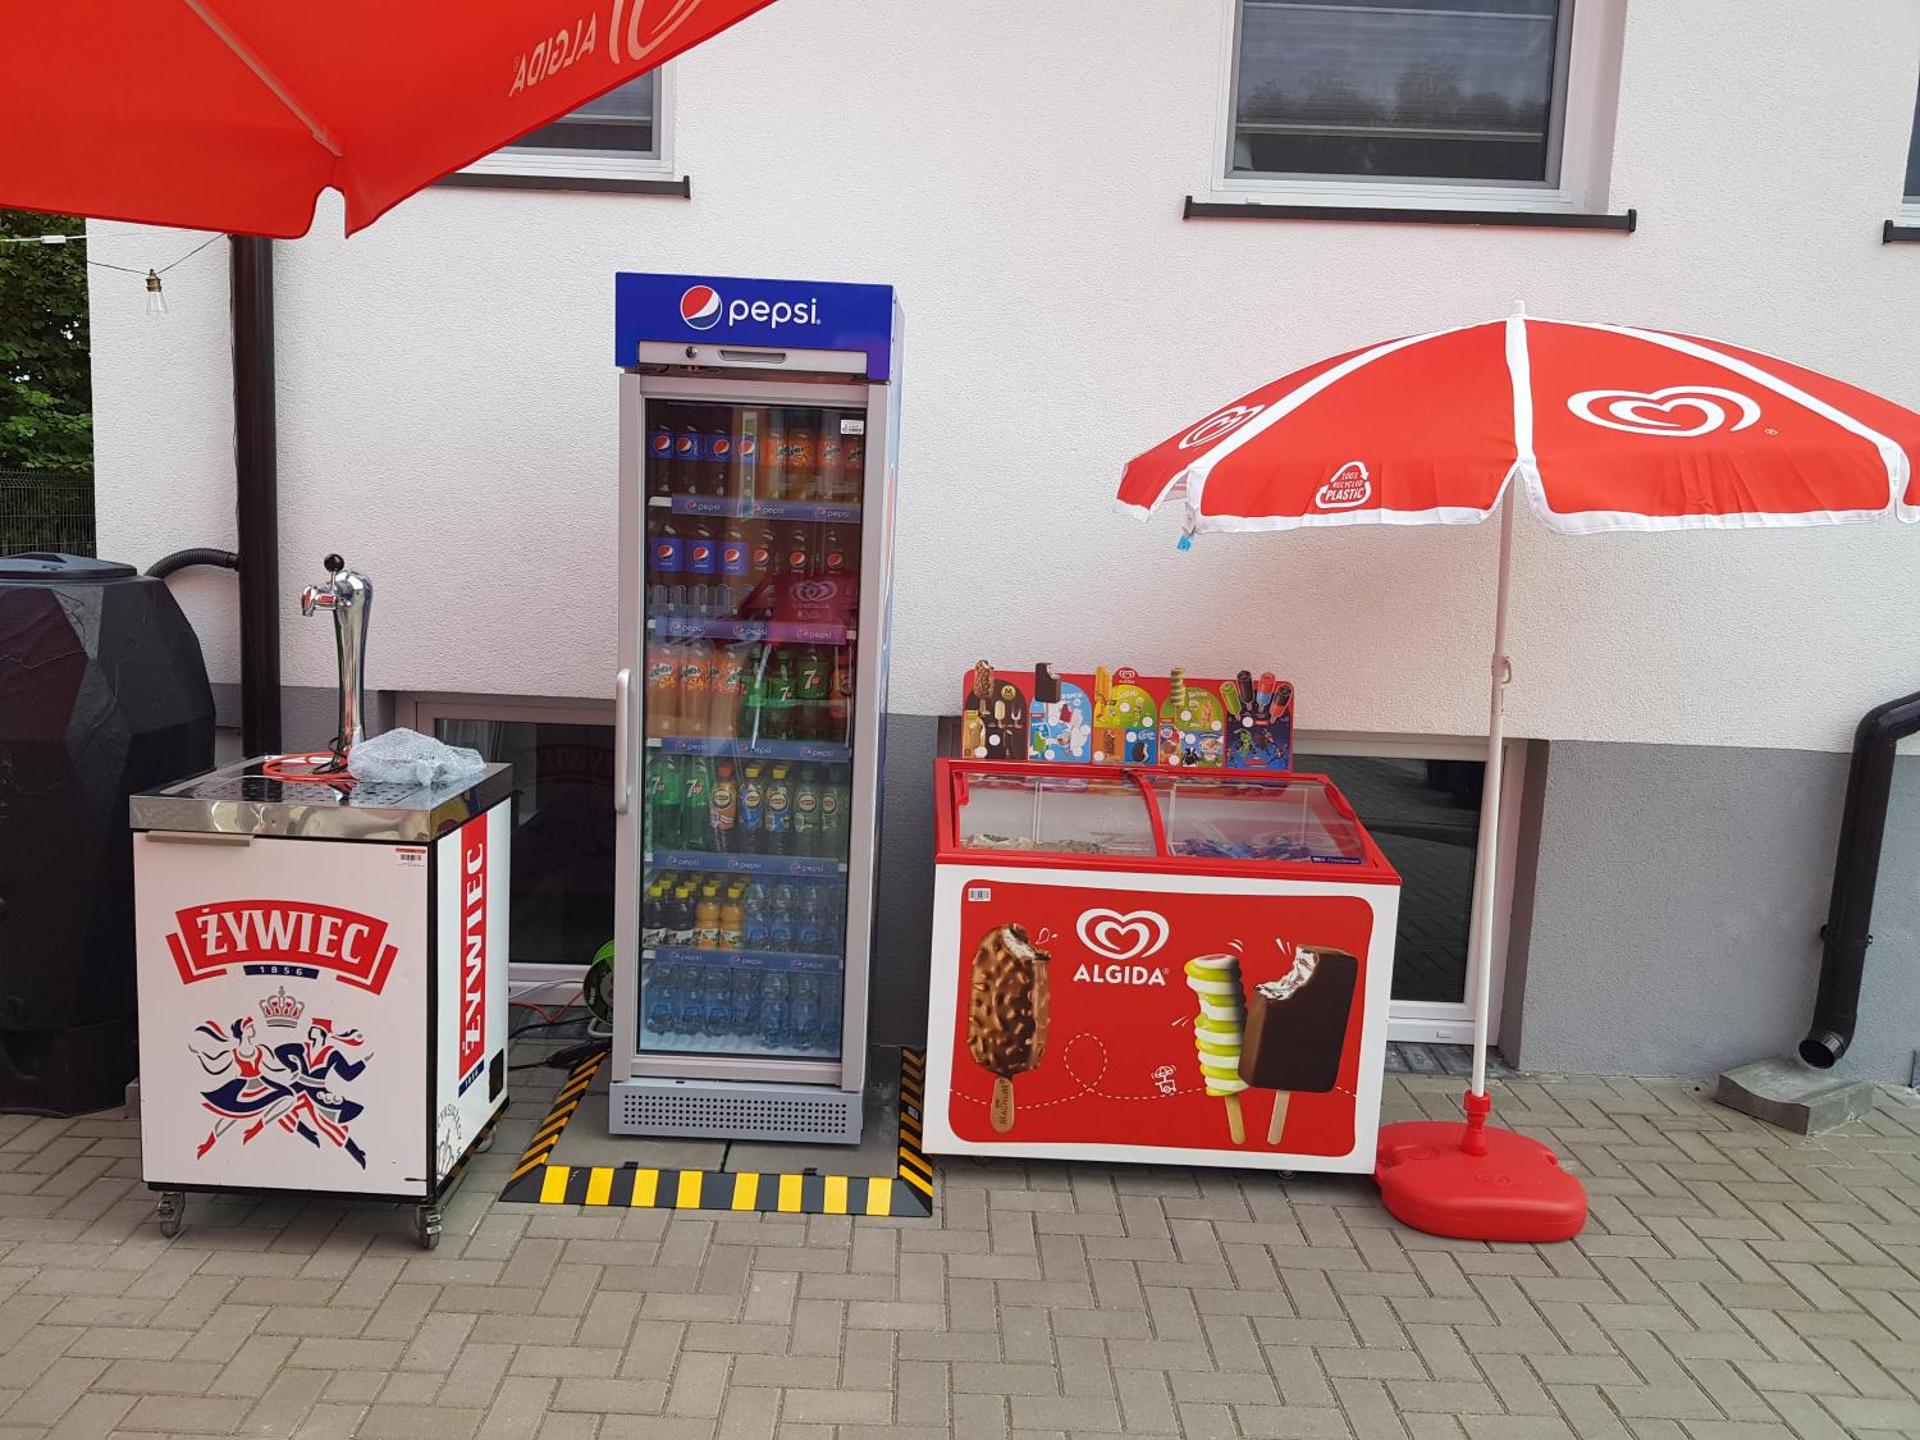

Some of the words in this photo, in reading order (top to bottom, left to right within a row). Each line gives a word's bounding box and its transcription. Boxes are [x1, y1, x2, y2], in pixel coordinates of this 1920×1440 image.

[728, 297, 817, 329] pepsi
[195, 907, 370, 965] ŻYWIEC
[461, 842, 484, 1057] ŻYWIEC
[259, 965, 304, 976] 1856
[1072, 963, 1167, 987] ALGIDA
